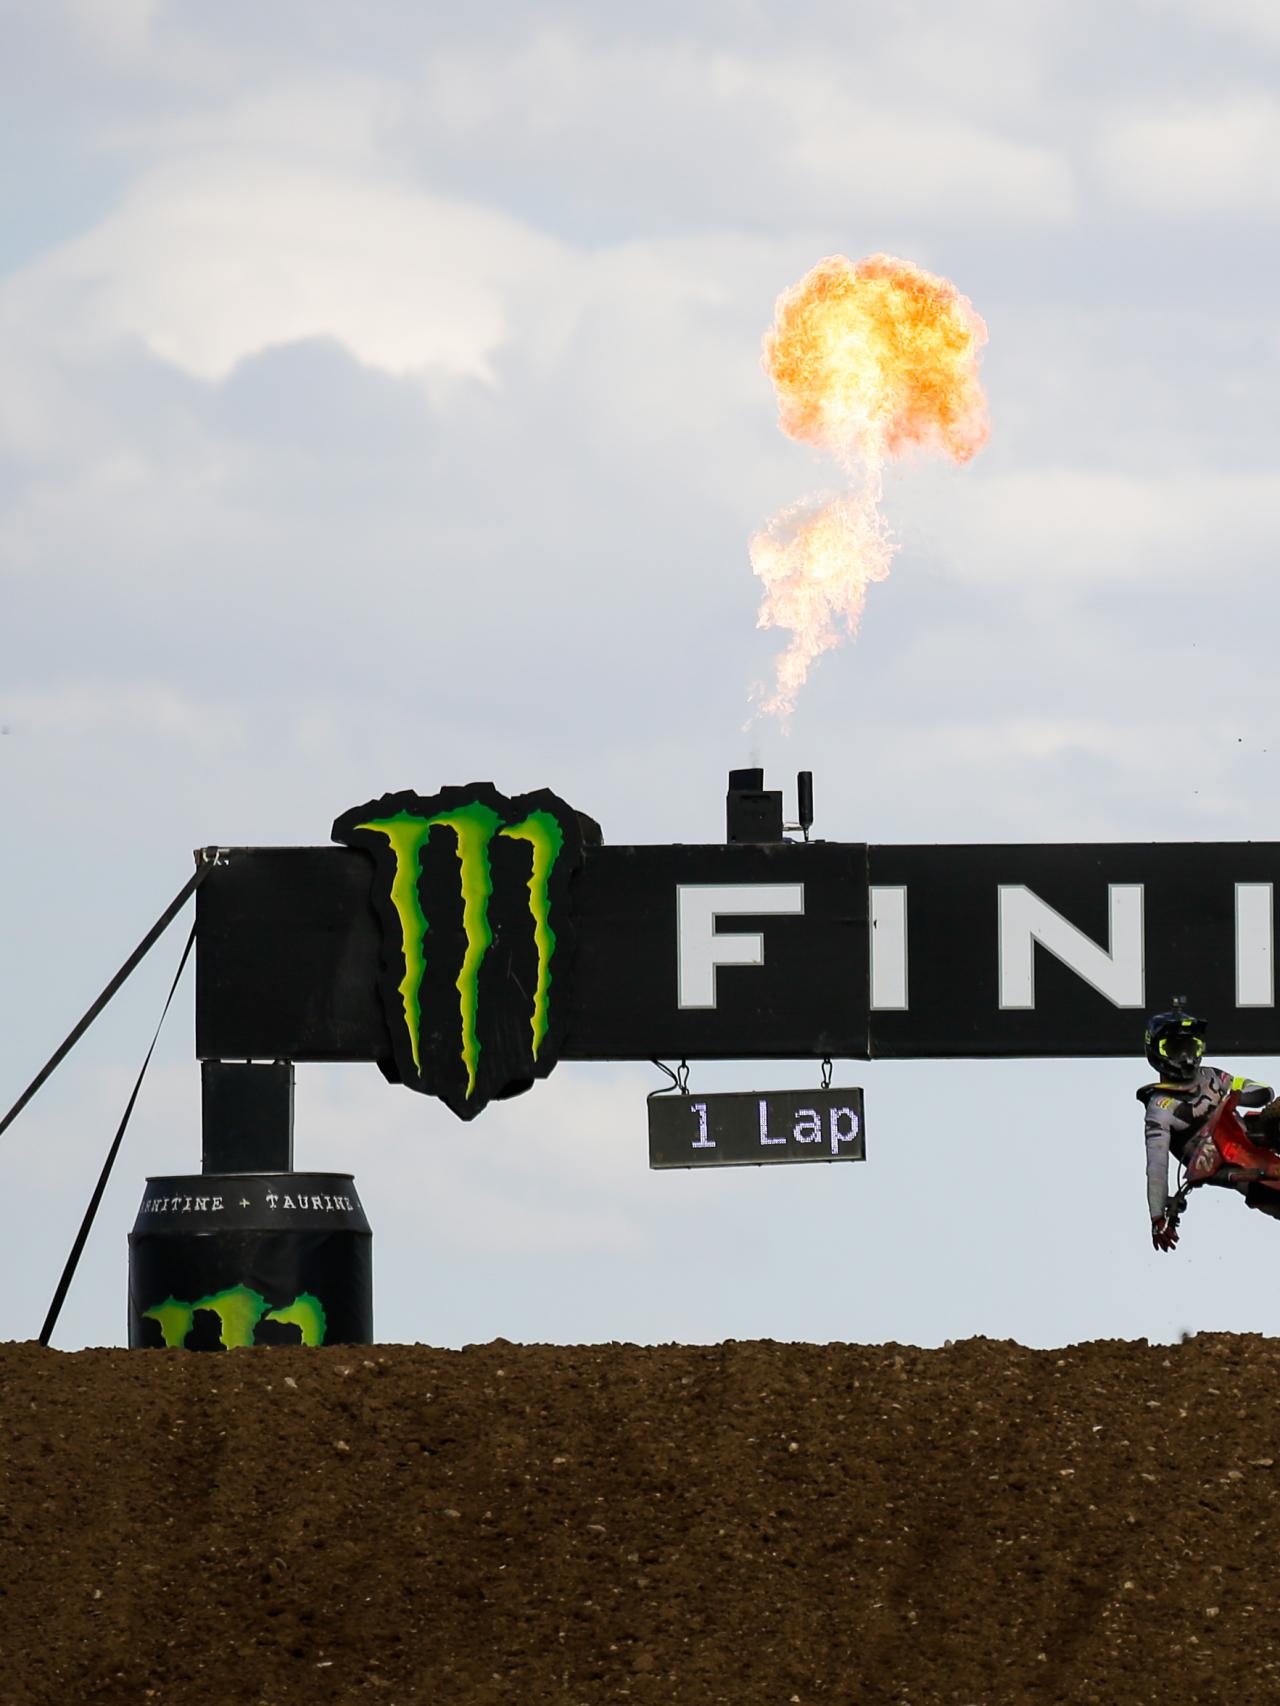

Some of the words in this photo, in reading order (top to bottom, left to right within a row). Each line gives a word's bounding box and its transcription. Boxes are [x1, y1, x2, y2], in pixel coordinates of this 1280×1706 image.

[691, 1103, 716, 1148] 1
[759, 1100, 859, 1154] Lap
[266, 1193, 354, 1212] TAURINE
